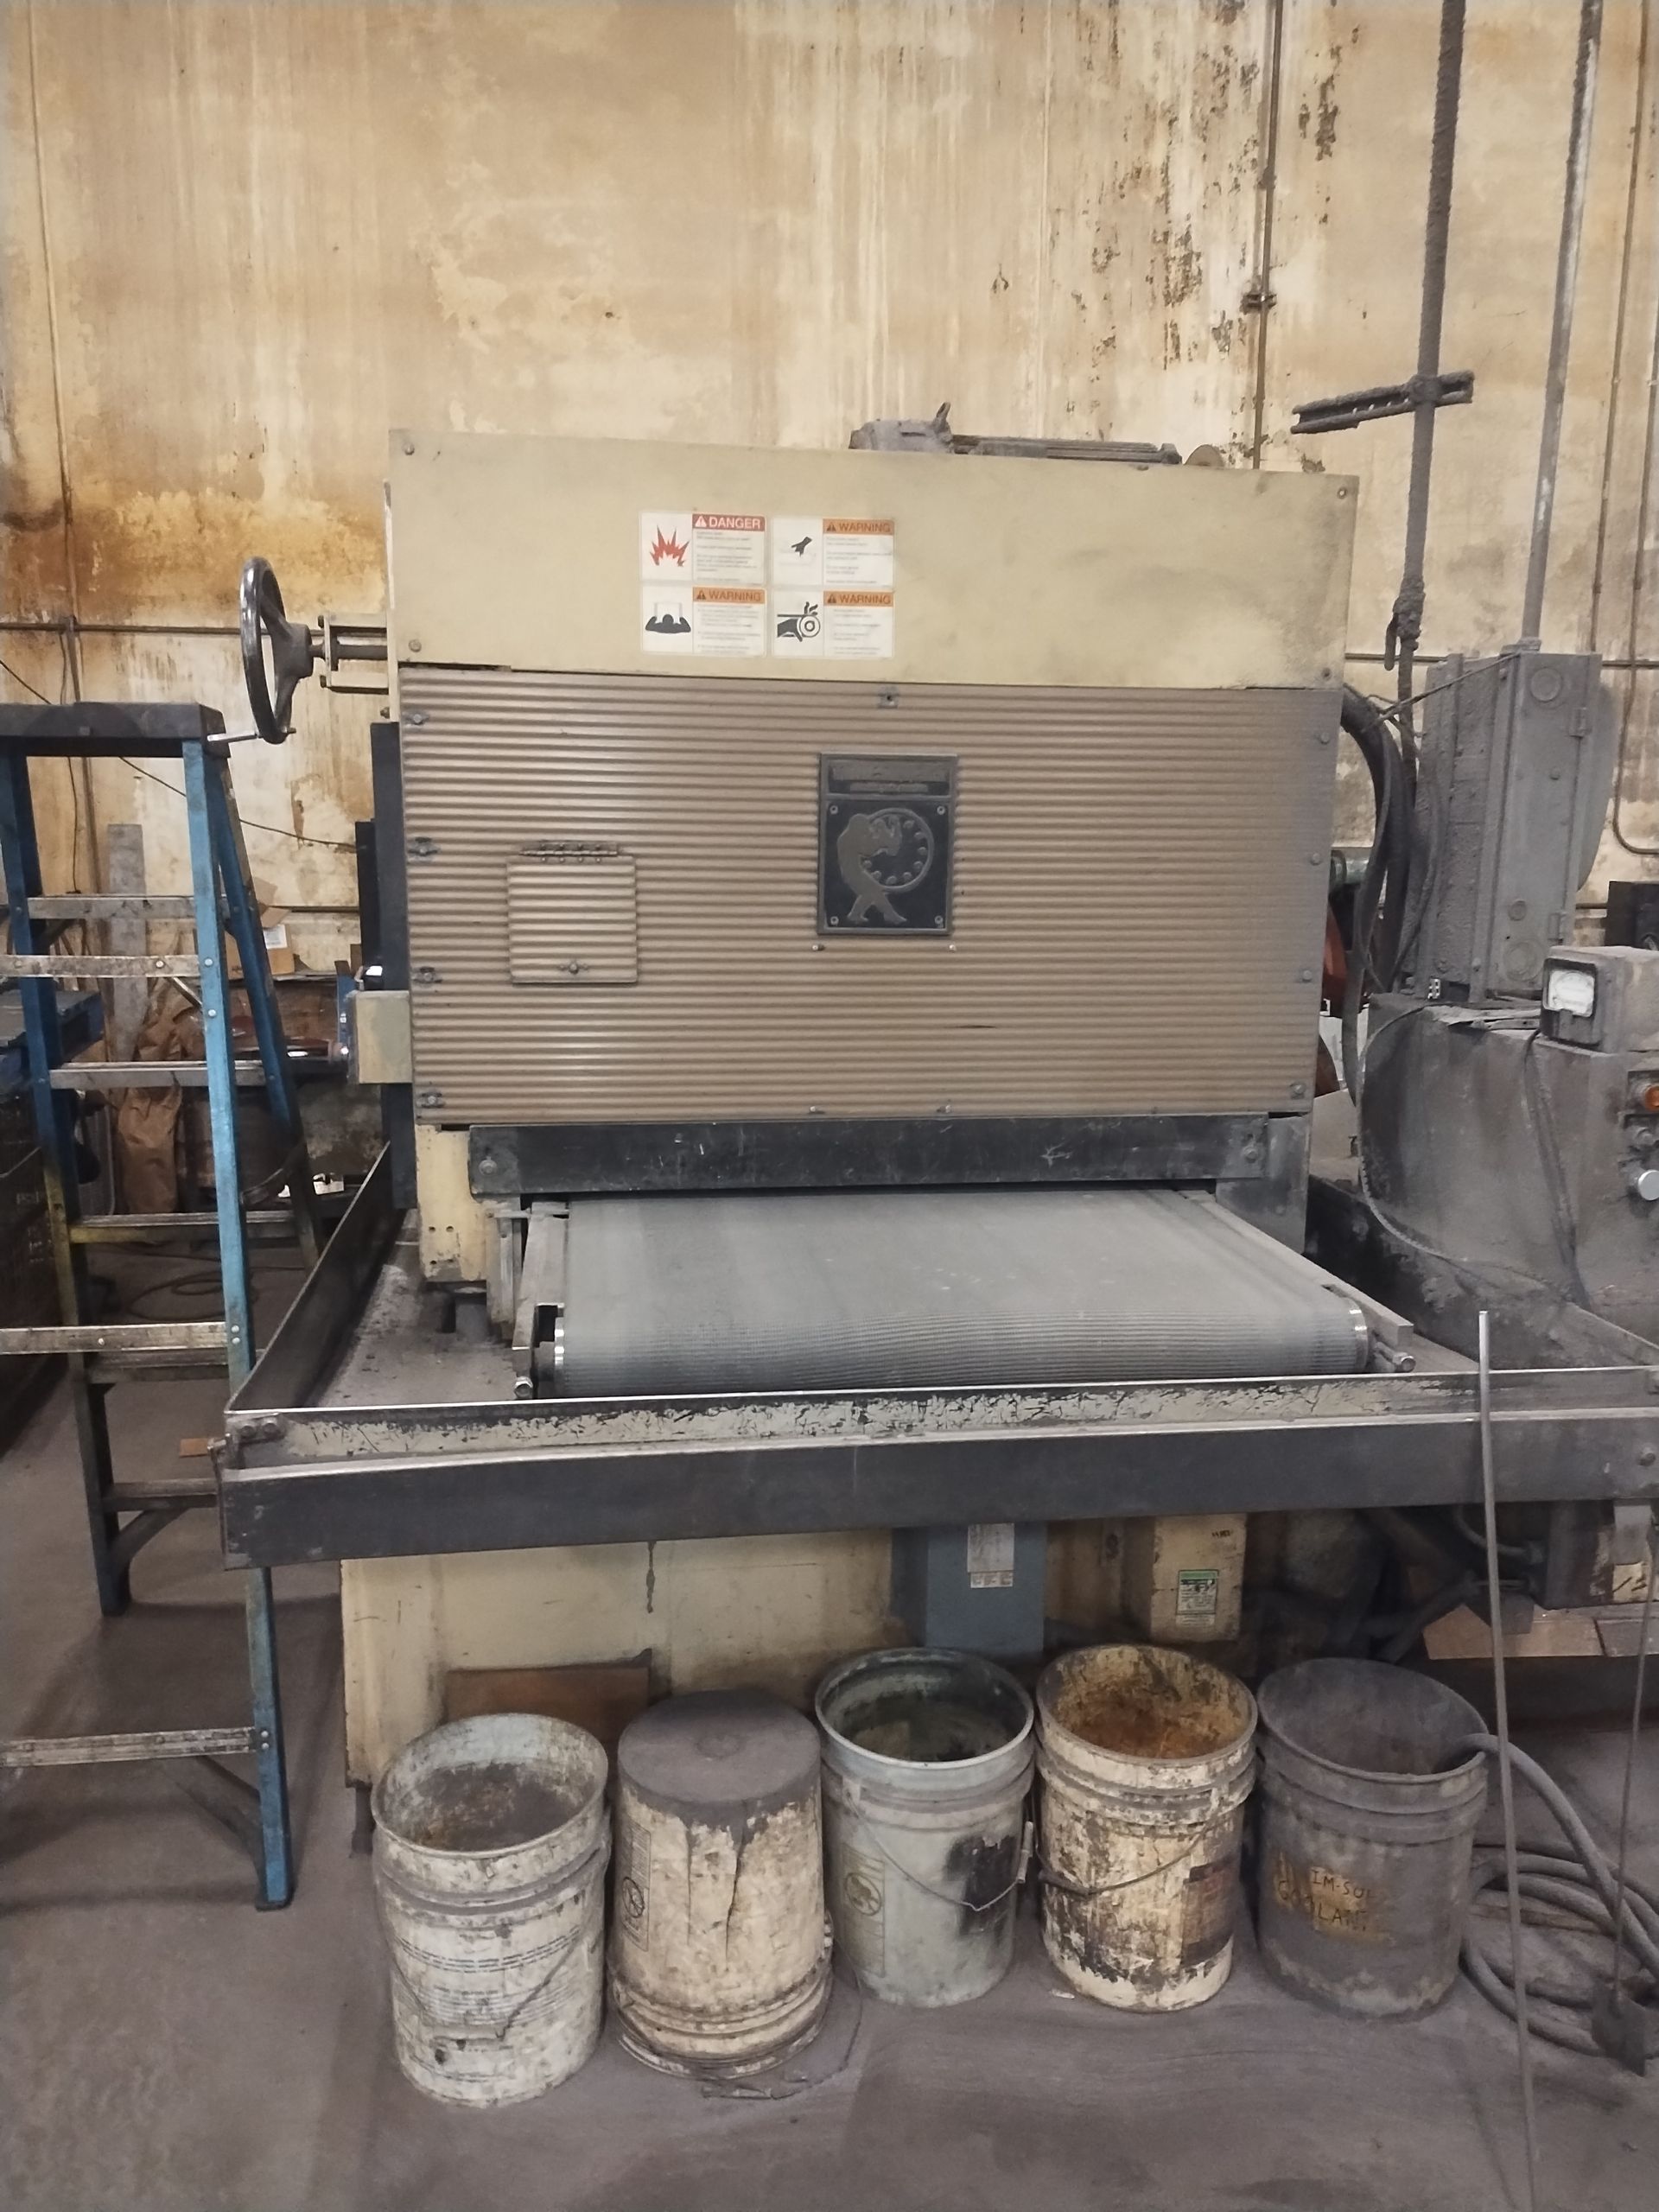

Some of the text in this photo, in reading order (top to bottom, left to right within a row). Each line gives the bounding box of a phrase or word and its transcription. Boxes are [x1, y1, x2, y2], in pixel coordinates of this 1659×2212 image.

[709, 516, 761, 530] DANGER
[839, 522, 891, 533] WARNING
[709, 590, 761, 602] WARNING
[839, 594, 891, 605] WARNING
